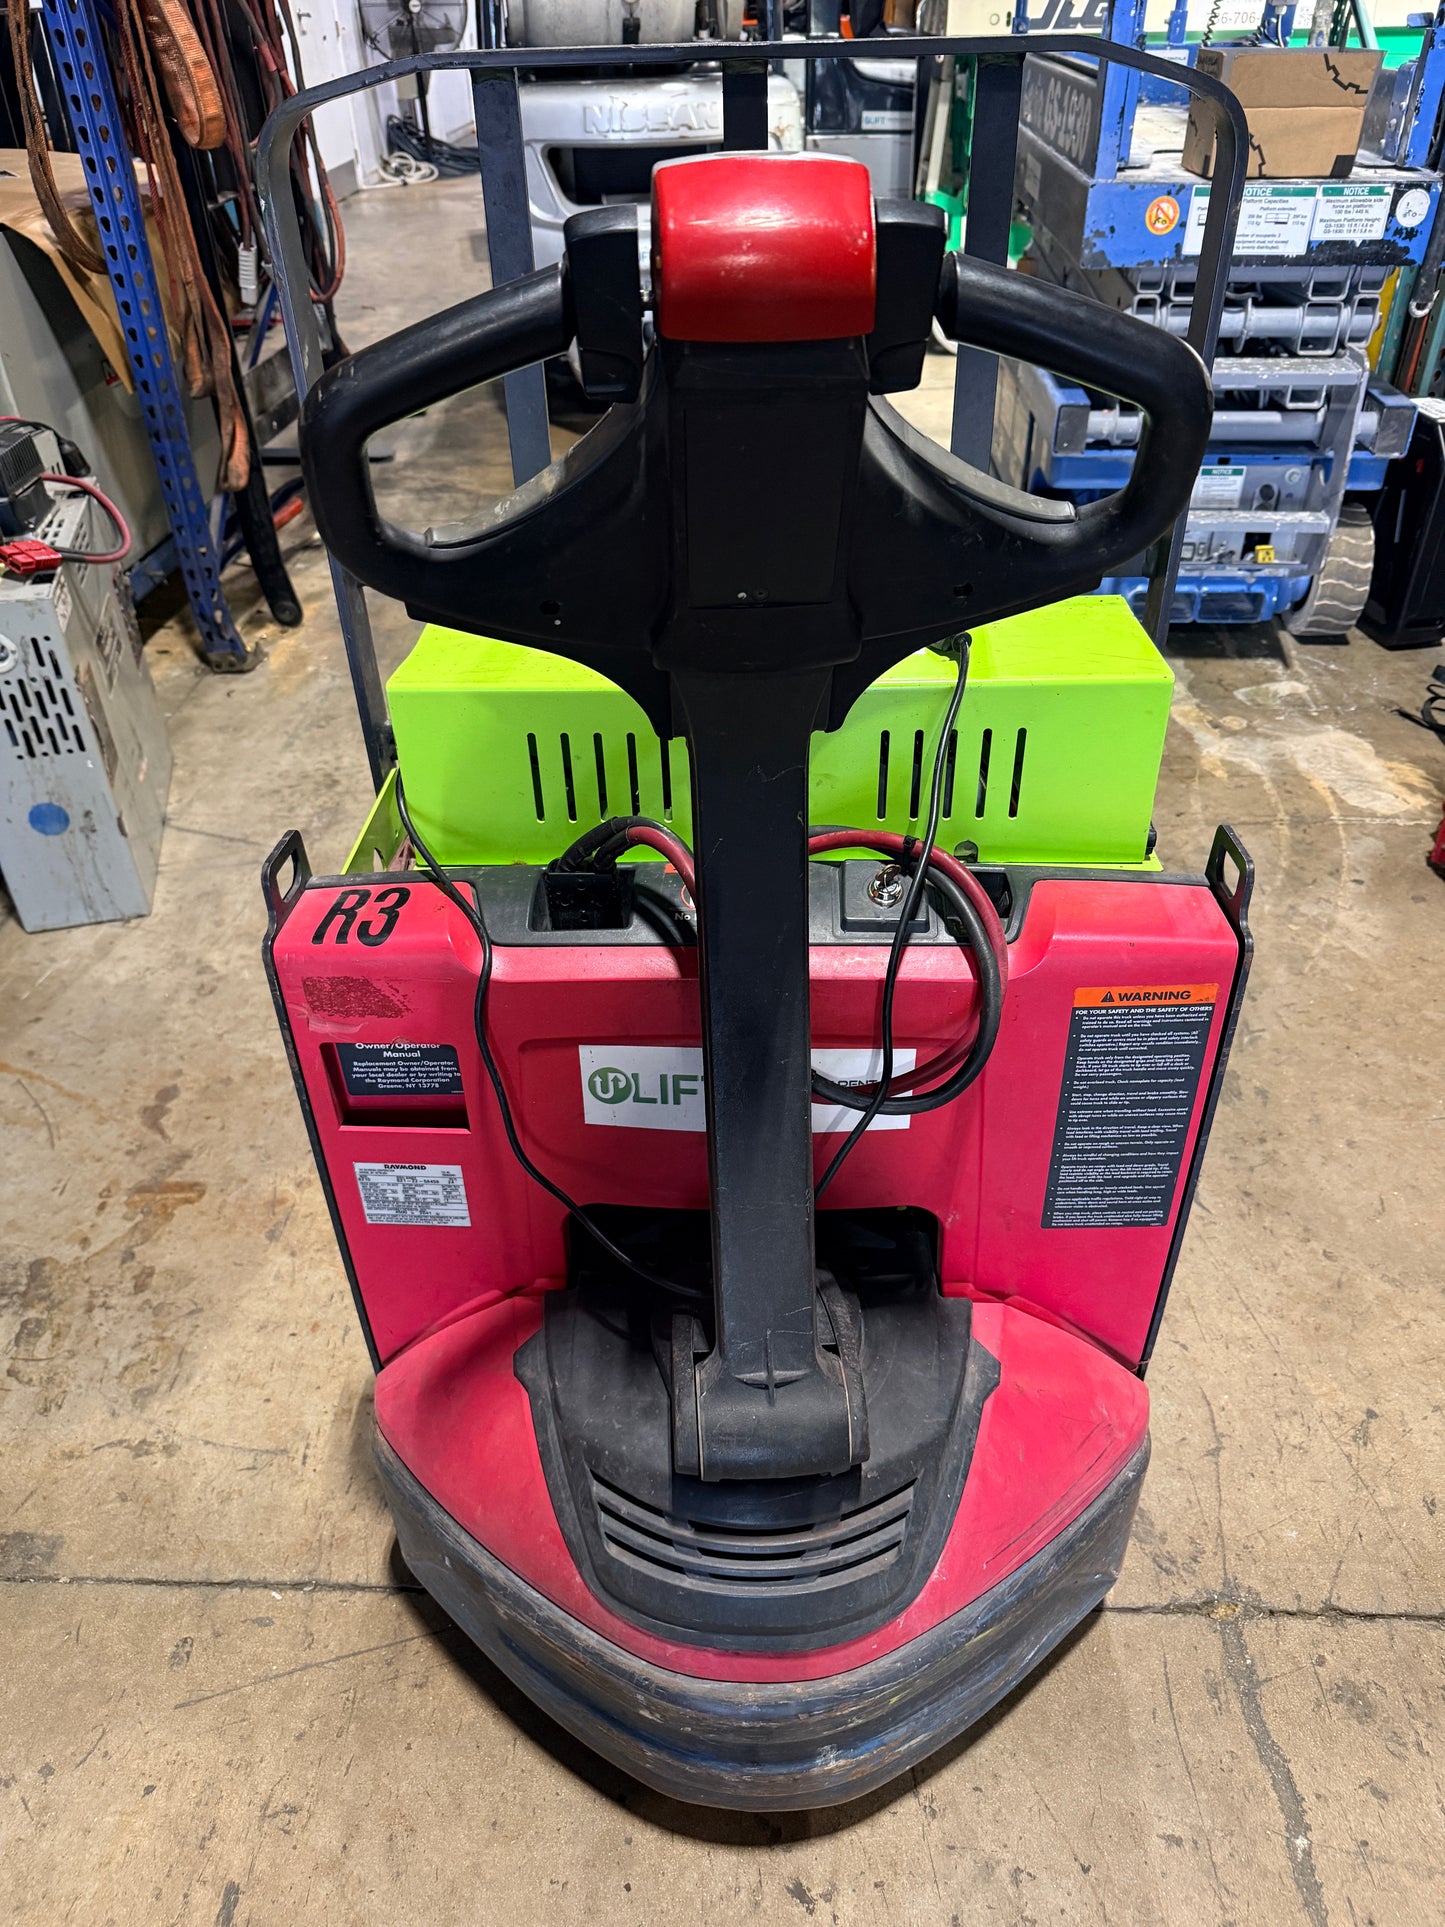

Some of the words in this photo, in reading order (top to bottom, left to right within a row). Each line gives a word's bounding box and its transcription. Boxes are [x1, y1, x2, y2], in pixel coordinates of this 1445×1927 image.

[1344, 187, 1370, 196] NOTICE
[311, 887, 411, 947] R3
[1118, 990, 1191, 1002] WARNING
[355, 1042, 440, 1050] Owner/Operator
